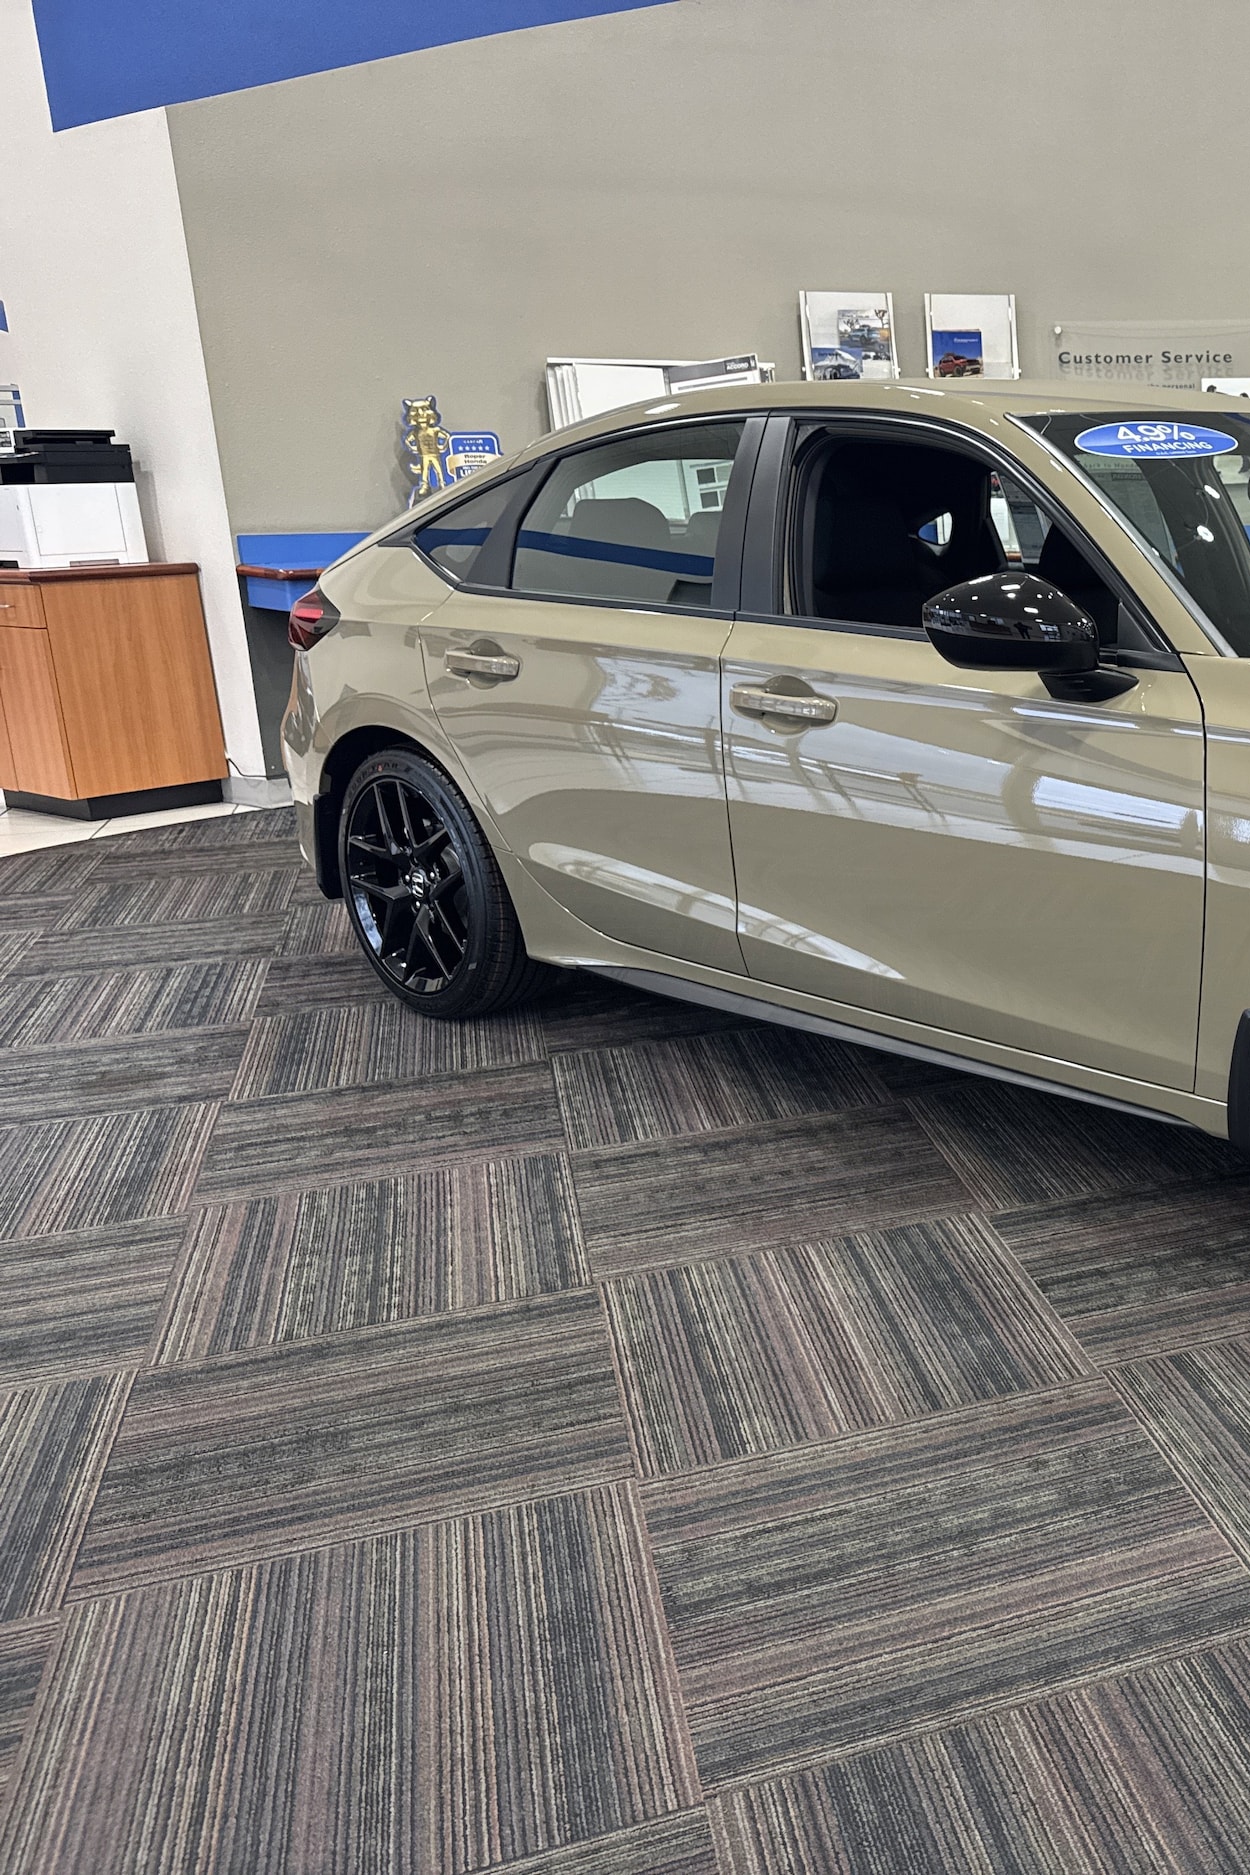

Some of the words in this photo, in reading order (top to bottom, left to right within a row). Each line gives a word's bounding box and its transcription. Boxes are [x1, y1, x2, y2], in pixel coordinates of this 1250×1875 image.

[1058, 351, 1153, 365] Customer
[1161, 350, 1233, 364] Service
[1117, 424, 1196, 442] 4.9%
[1122, 440, 1213, 454] FINANCING
